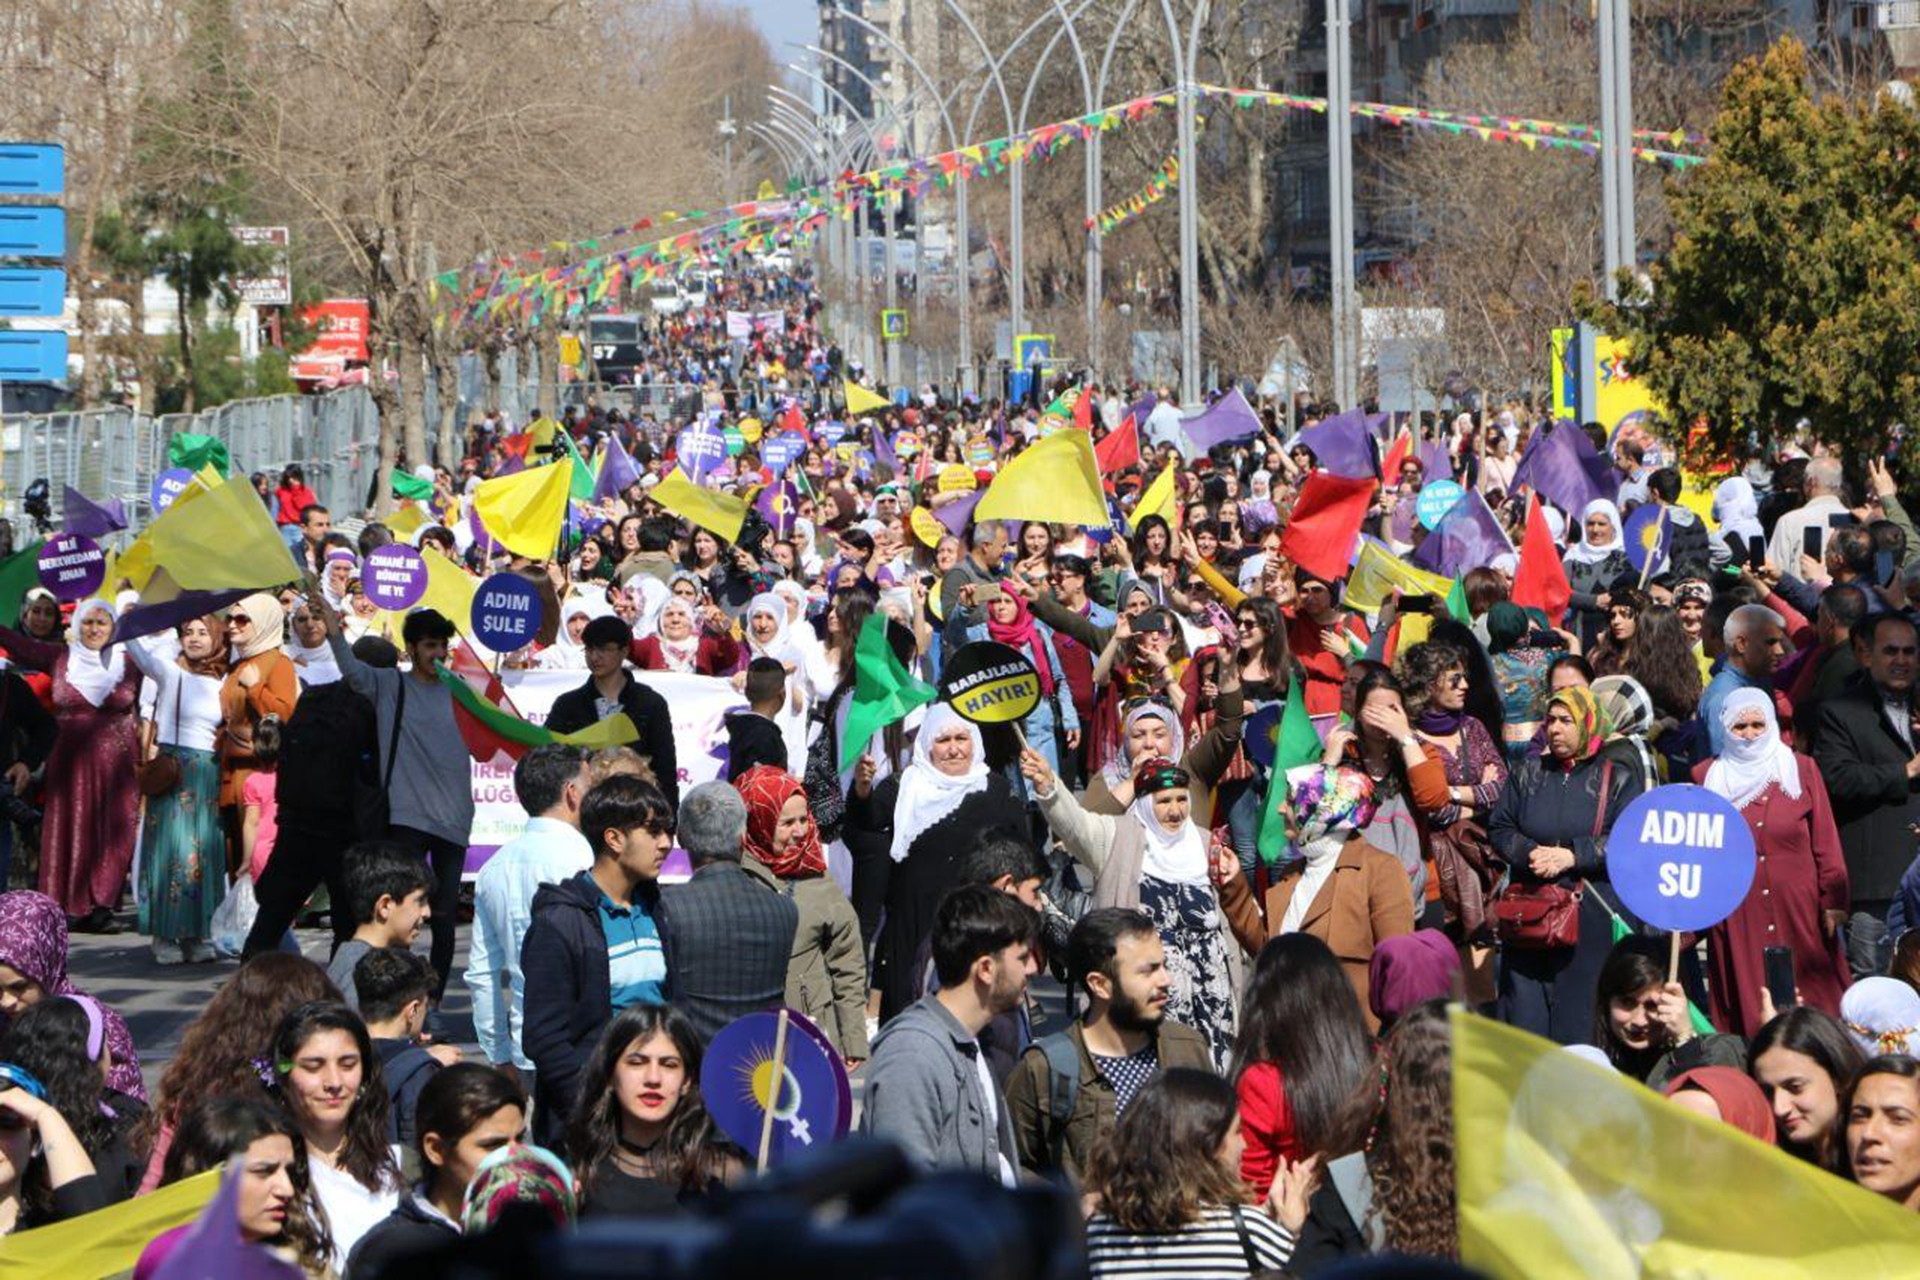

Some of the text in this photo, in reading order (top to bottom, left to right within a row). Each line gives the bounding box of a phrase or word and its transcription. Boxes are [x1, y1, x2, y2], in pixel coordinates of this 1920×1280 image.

[593, 345, 617, 360] 57
[483, 591, 530, 612] ADIM
[483, 614, 526, 634] ŞULE
[947, 661, 1030, 695] BARAJLARA
[965, 680, 1035, 714] HAYIR!
[472, 784, 520, 803] LÜĞ
[1640, 809, 1725, 849] ADIM
[1658, 861, 1702, 899] SU
